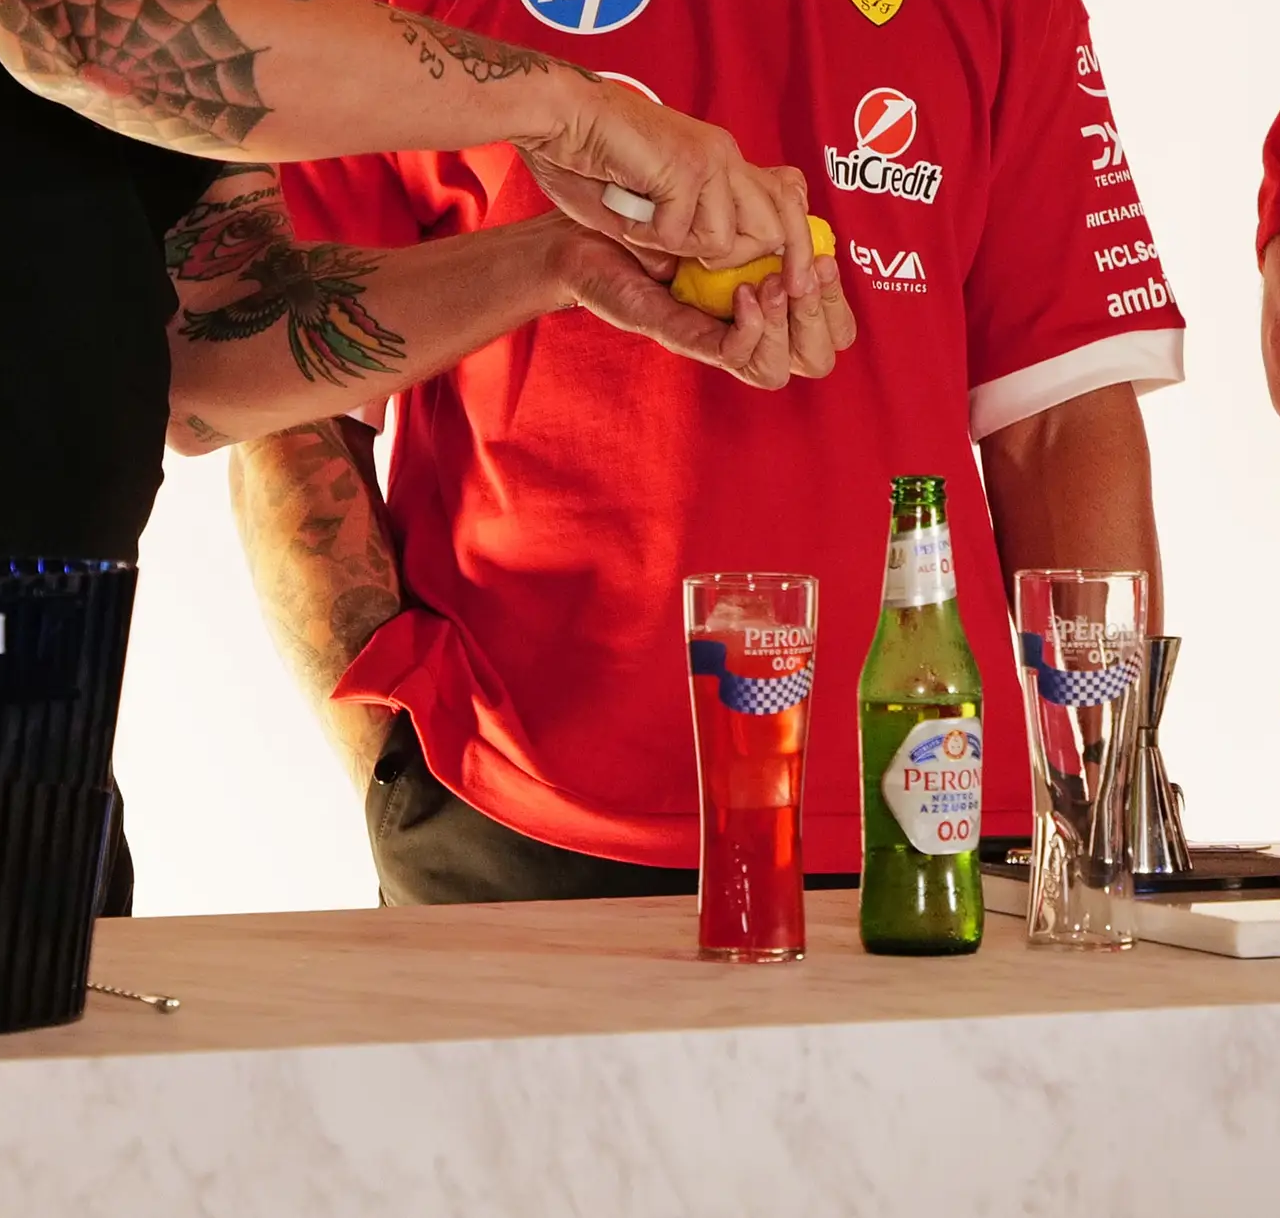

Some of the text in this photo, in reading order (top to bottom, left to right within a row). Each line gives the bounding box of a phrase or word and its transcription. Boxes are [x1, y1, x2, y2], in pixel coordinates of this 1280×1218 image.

[826, 146, 941, 202] UniCredit
[872, 280, 928, 294] LOGISTICS
[932, 792, 974, 803] NASTRO
